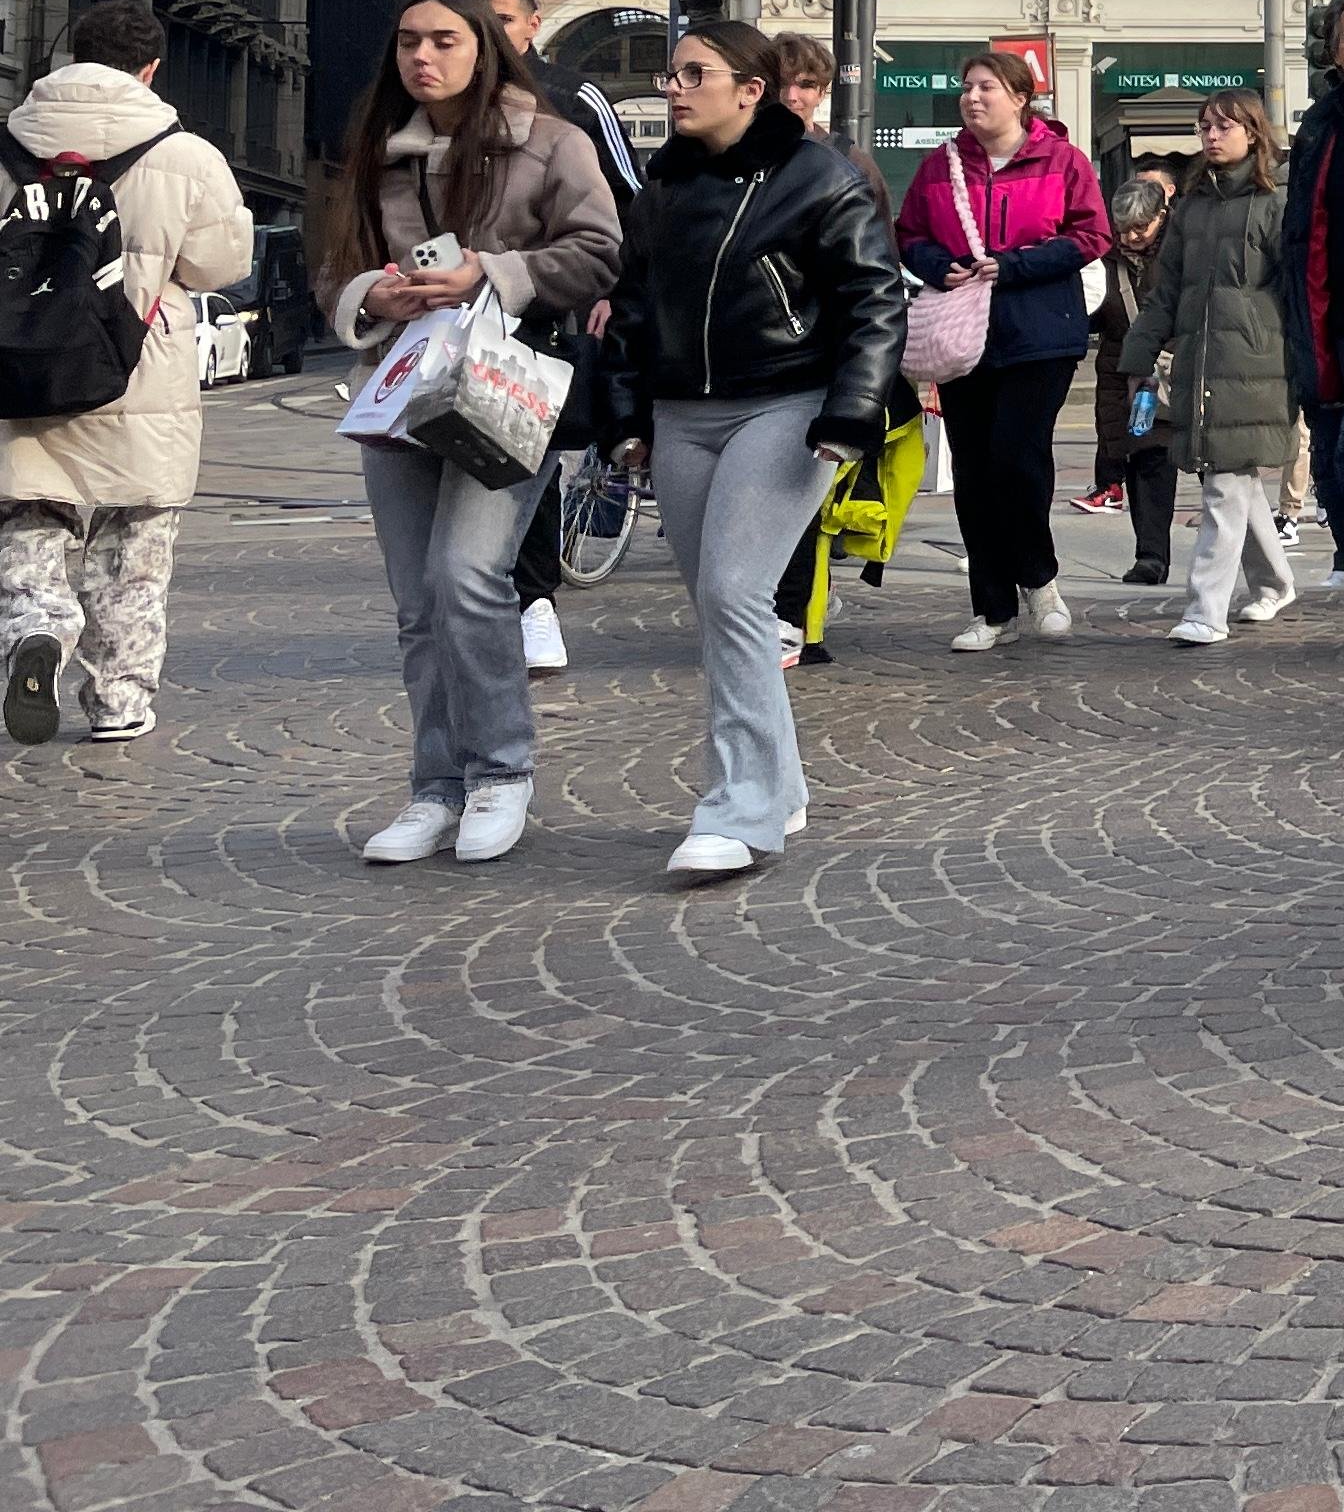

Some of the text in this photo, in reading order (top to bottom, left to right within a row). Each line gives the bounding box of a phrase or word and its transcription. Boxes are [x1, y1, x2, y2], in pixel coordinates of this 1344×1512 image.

[883, 75, 927, 88] INTESA
[1118, 75, 1244, 87] INTESA SANPAOLO
